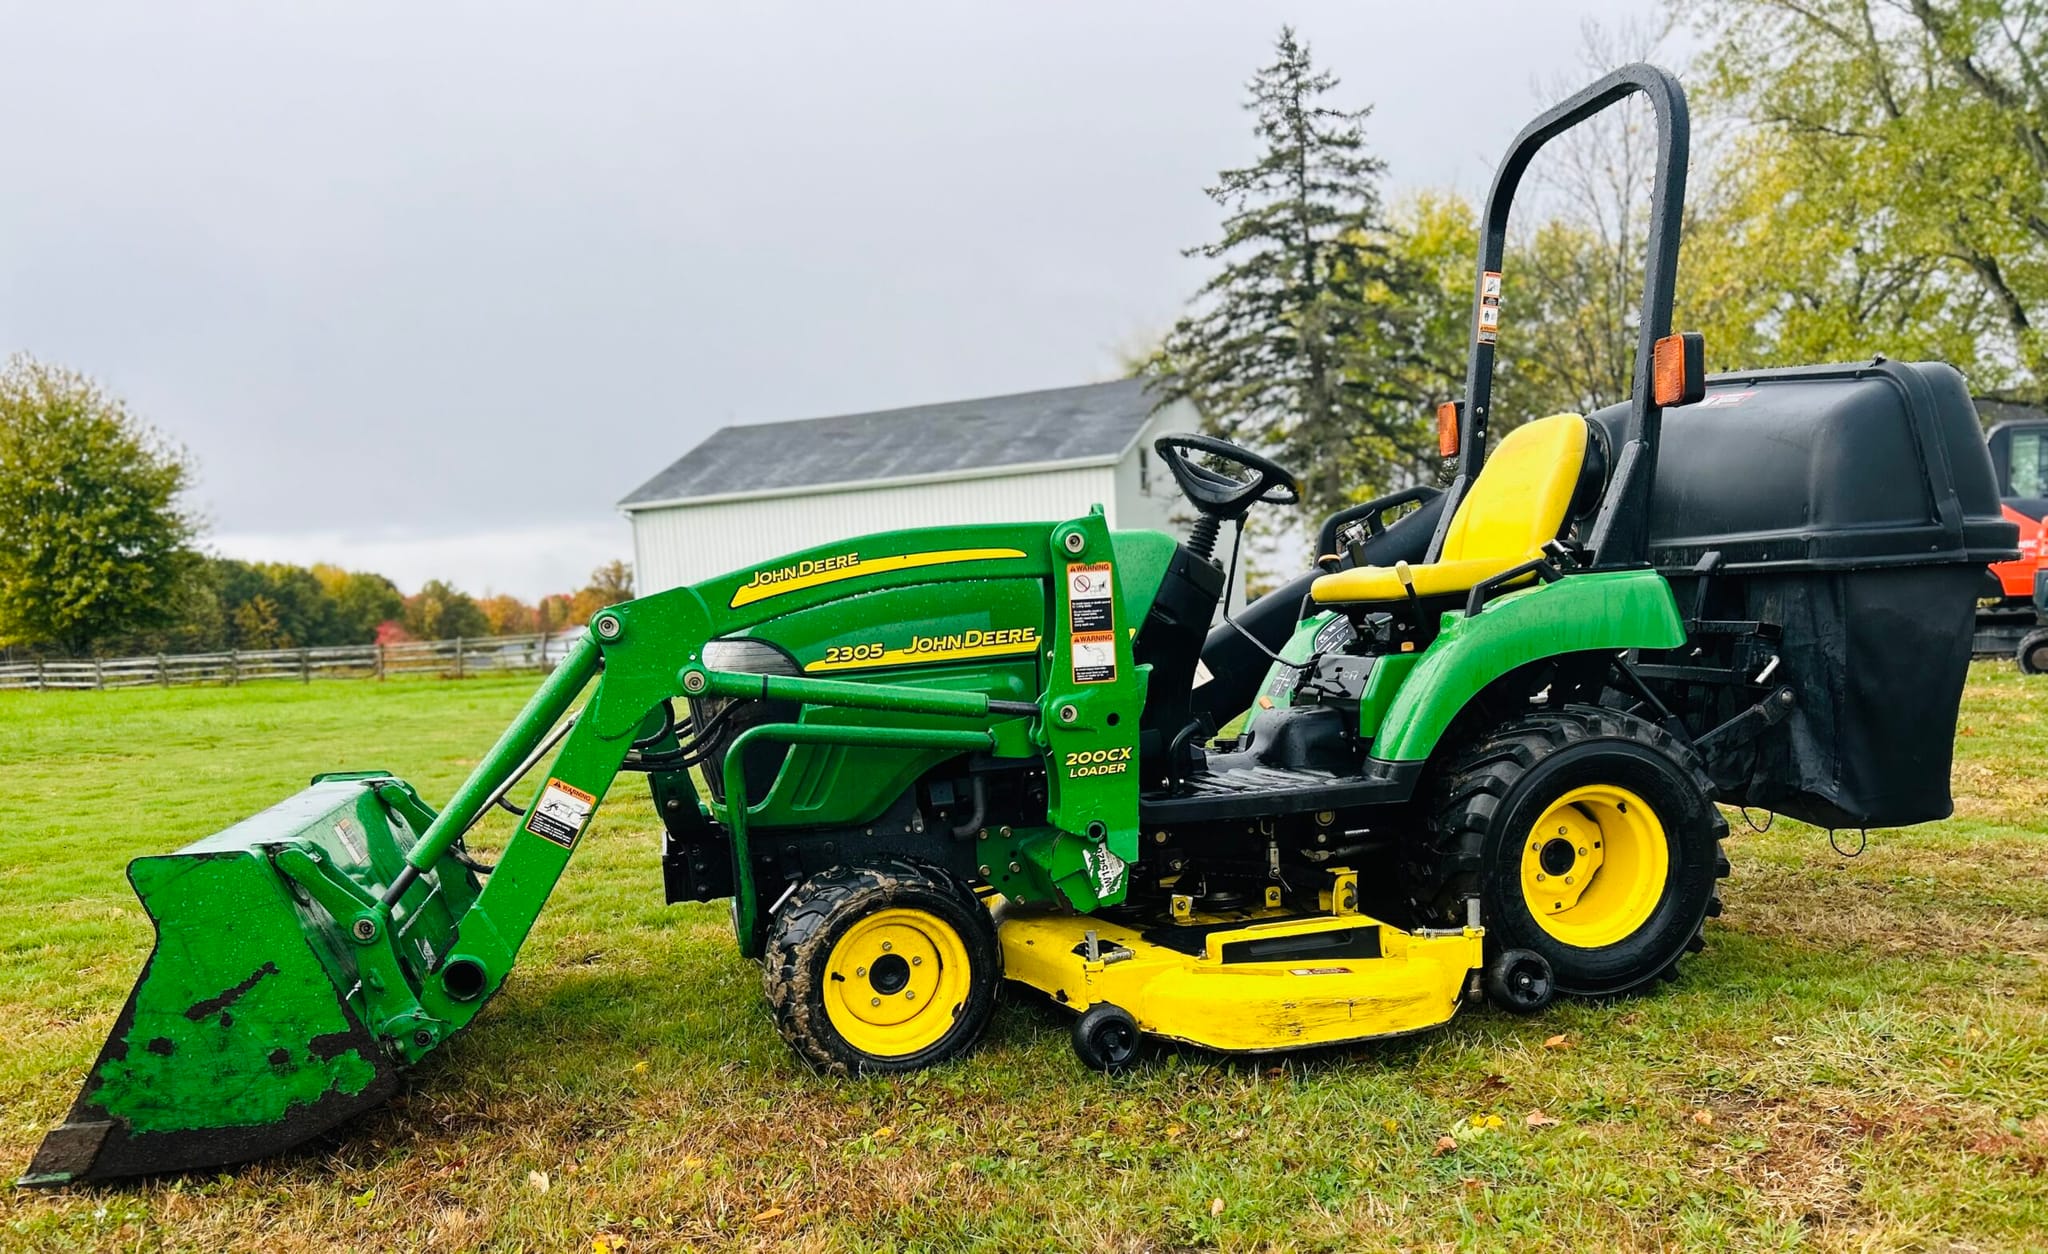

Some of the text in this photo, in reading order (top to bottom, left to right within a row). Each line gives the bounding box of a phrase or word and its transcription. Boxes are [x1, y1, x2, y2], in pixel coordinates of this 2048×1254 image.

[747, 552, 860, 589] JOHN DEERE
[825, 626, 1037, 664] 2305 JOHN DEERE
[1065, 746, 1133, 766] 200CX
[1069, 763, 1127, 778] LOADER
